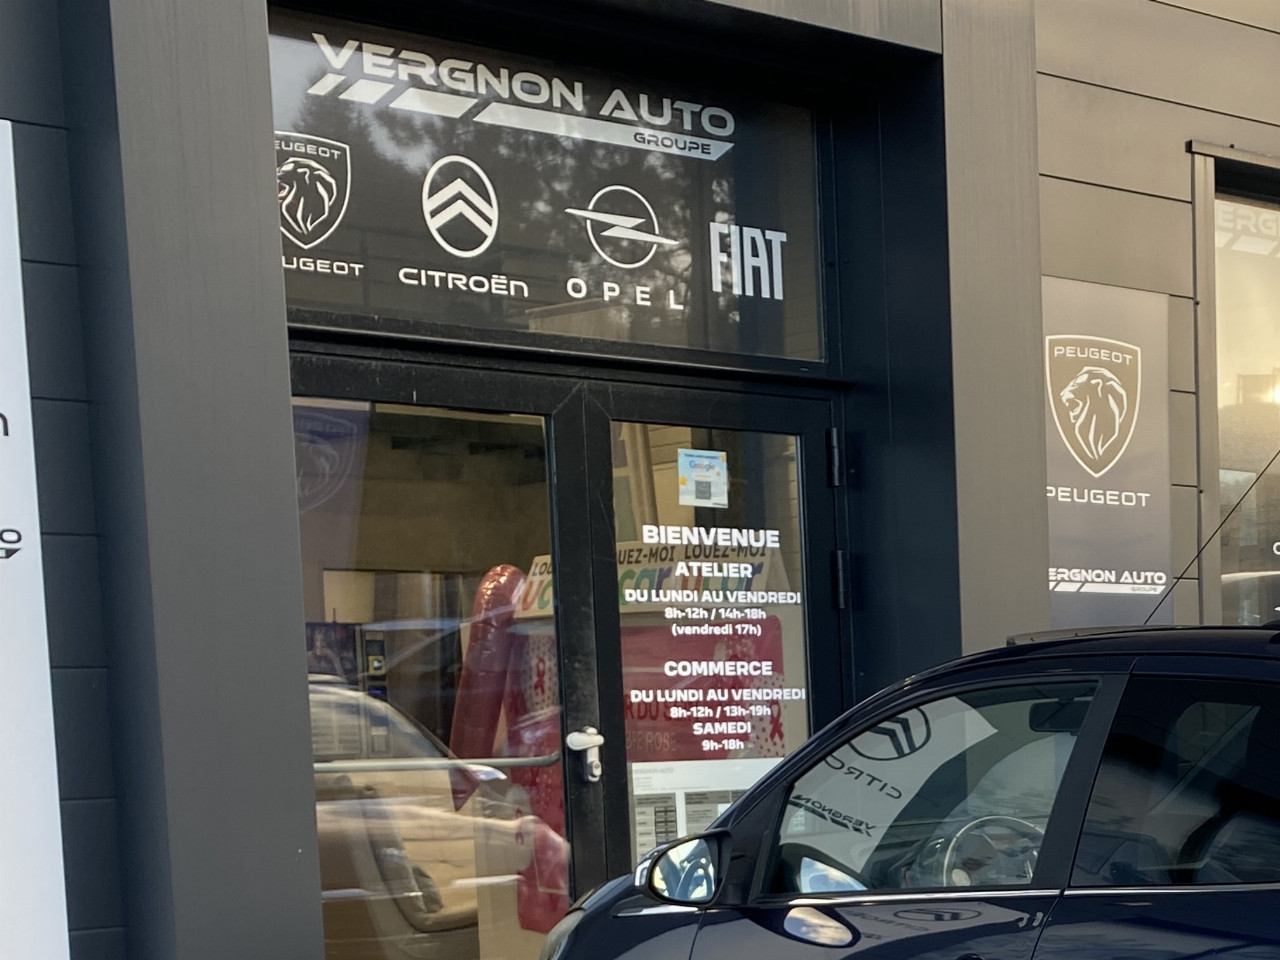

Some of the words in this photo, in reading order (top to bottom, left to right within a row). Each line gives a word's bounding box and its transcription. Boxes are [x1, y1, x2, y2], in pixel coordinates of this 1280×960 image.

[312, 33, 583, 111] VERGNON
[599, 88, 735, 136] AUTO
[274, 140, 341, 159] EUGEOT
[633, 132, 712, 155] GROUPE
[282, 256, 364, 276] UGEOT
[709, 222, 788, 300] FIAT
[566, 277, 684, 311] OPEL
[1054, 346, 1133, 365] PEUGEOT
[642, 524, 780, 548] BIENVENUE
[618, 546, 674, 564] UEZ-MOI
[675, 561, 753, 578] ATELIER
[1048, 567, 1116, 583] ERGNON
[1120, 570, 1167, 584] AUTO
[625, 589, 648, 602] DU
[651, 589, 698, 603] LUNDI
[701, 590, 724, 603] AU
[726, 591, 801, 604] VENDREDI
[664, 607, 708, 620] 8h-12h
[718, 608, 766, 620] 14h-18h
[672, 623, 733, 636] (vendredi
[735, 624, 762, 636] 17h)
[664, 661, 773, 677] COMMERCE
[630, 689, 653, 703] DU
[656, 689, 703, 702] LUNDI
[706, 688, 729, 701] AU
[731, 688, 806, 701] VENDREDI
[670, 706, 714, 719] 8h-12h
[723, 705, 772, 718] 13h-19h
[693, 721, 752, 735] SAMEDI
[701, 738, 745, 751] 9h-18h
